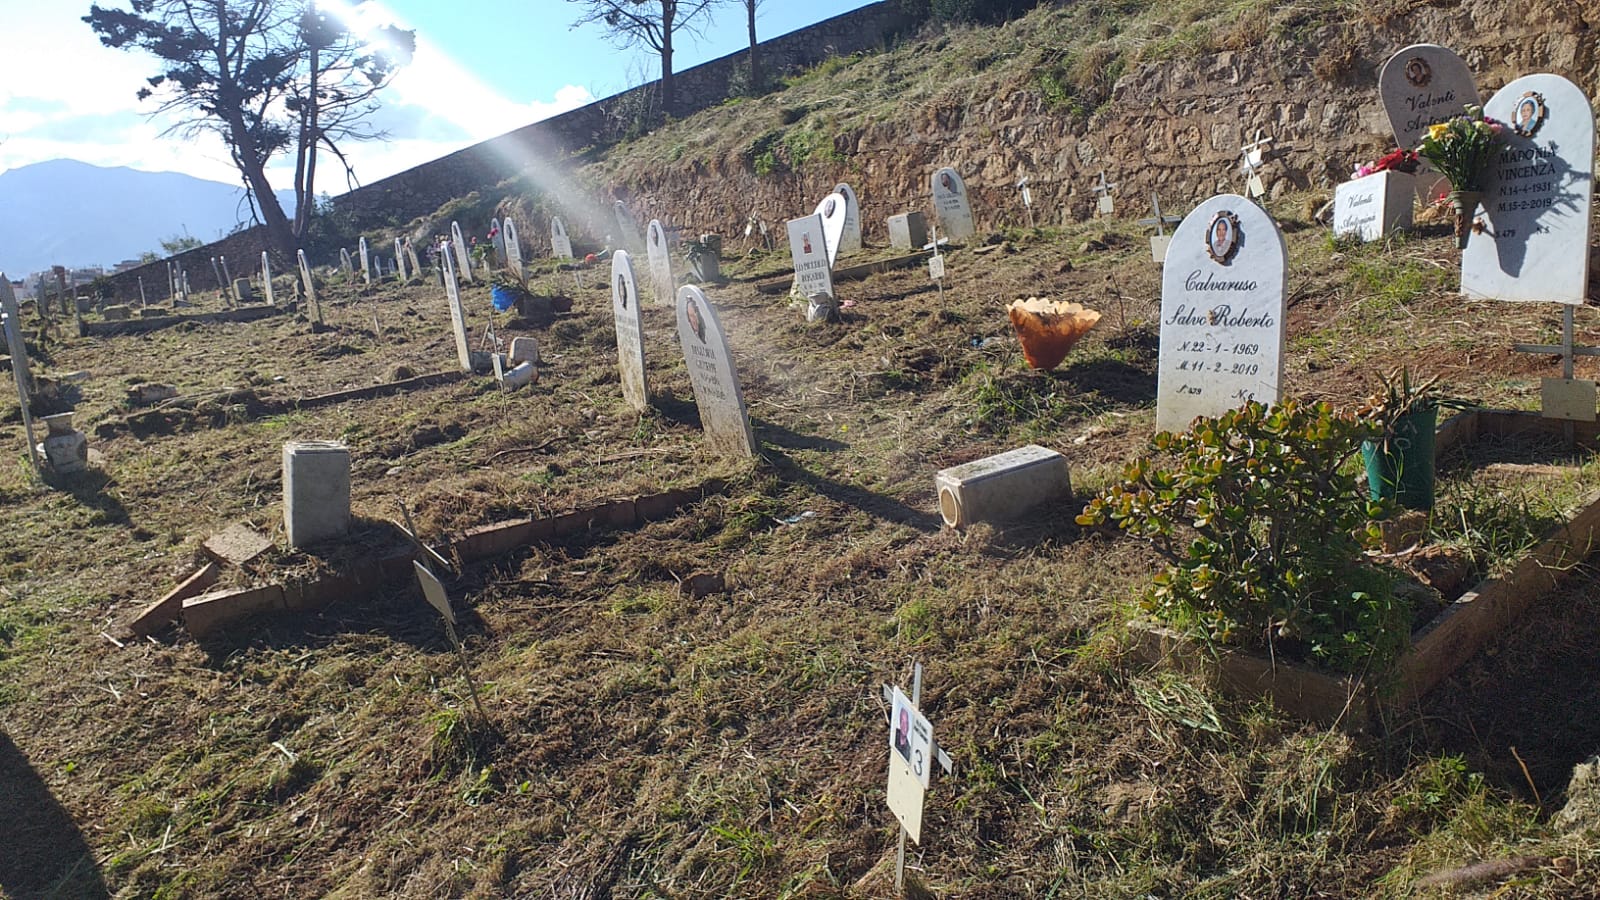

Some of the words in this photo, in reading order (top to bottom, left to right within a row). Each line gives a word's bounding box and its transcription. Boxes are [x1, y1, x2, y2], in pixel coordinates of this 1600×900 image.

[1405, 90, 1456, 112] Valenti
[1497, 163, 1556, 181] VINCENZA
[1185, 269, 1258, 291] Calvaruso
[1165, 304, 1207, 325] Salvo
[1210, 304, 1274, 328] Roberto
[914, 749, 923, 776] 3
